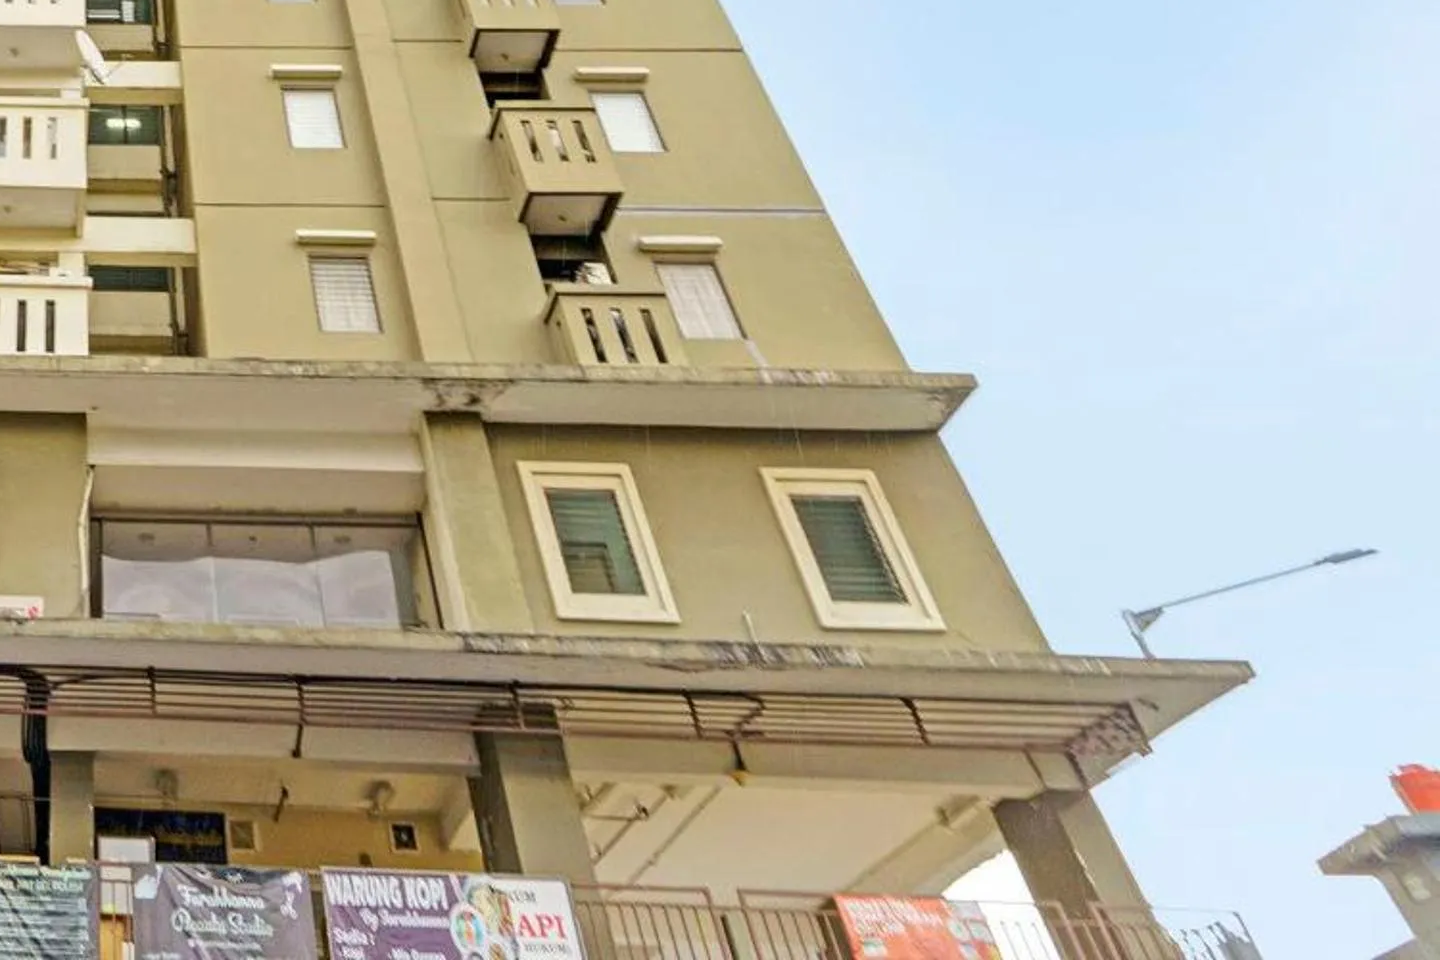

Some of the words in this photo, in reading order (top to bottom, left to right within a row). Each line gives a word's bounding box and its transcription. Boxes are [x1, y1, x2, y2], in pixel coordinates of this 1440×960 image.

[324, 874, 403, 909] WARUNG
[401, 877, 449, 911] KOPI
[518, 913, 567, 939] API
